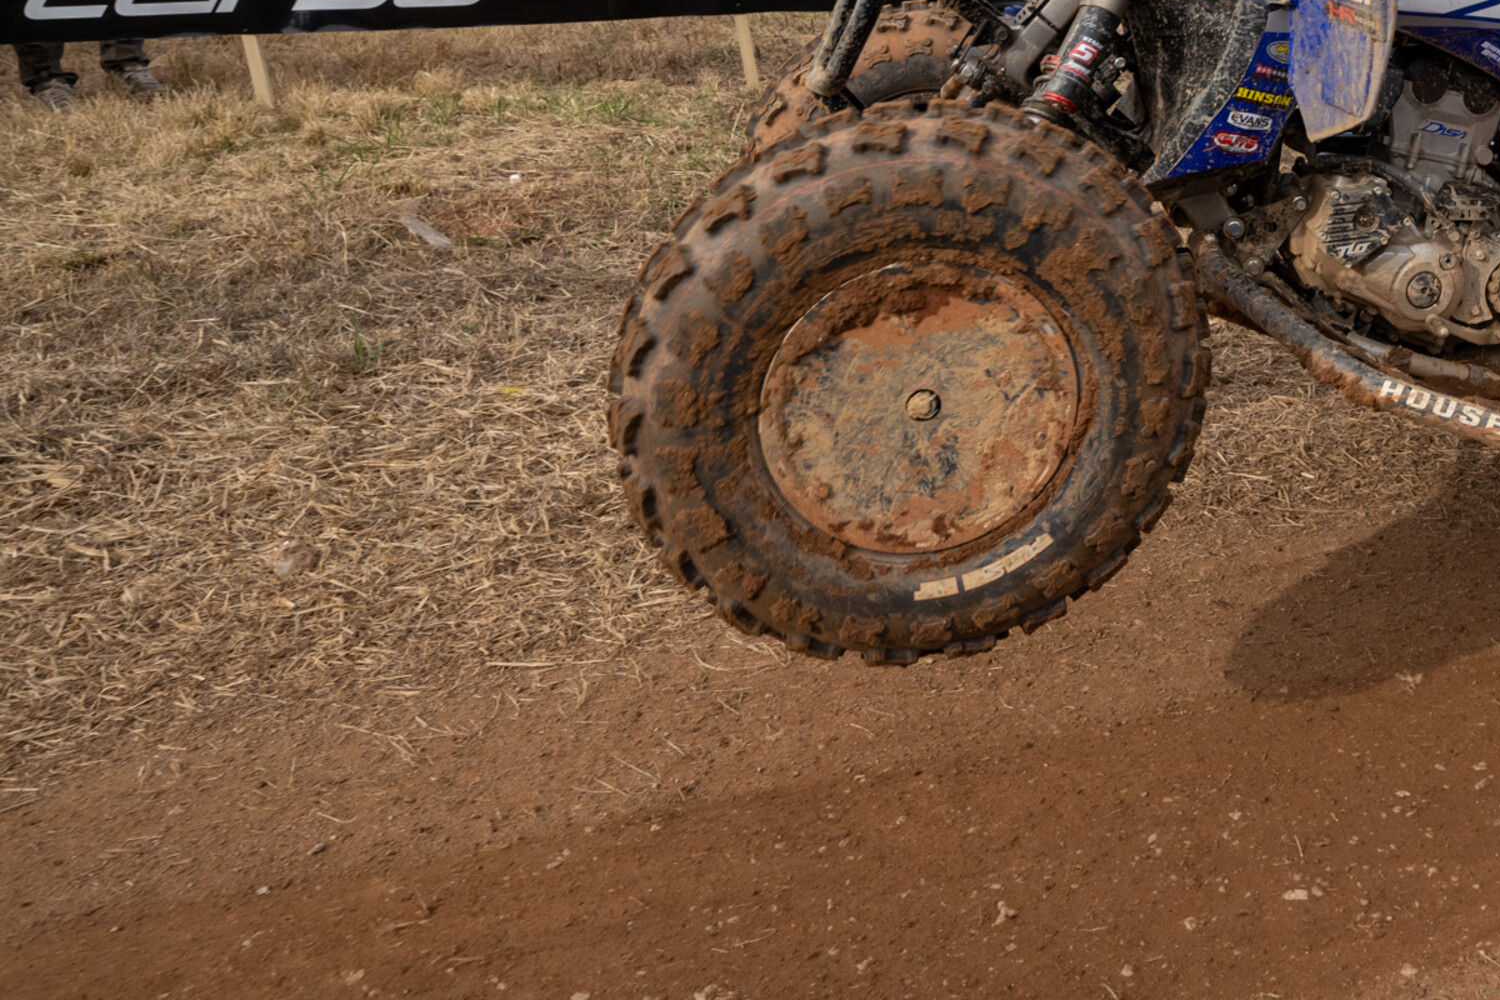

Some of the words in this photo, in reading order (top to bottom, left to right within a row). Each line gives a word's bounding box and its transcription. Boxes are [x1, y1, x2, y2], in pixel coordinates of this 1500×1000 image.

[1071, 43, 1098, 62] 5
[1235, 86, 1292, 106] HINSON
[1230, 112, 1270, 127] EVANS
